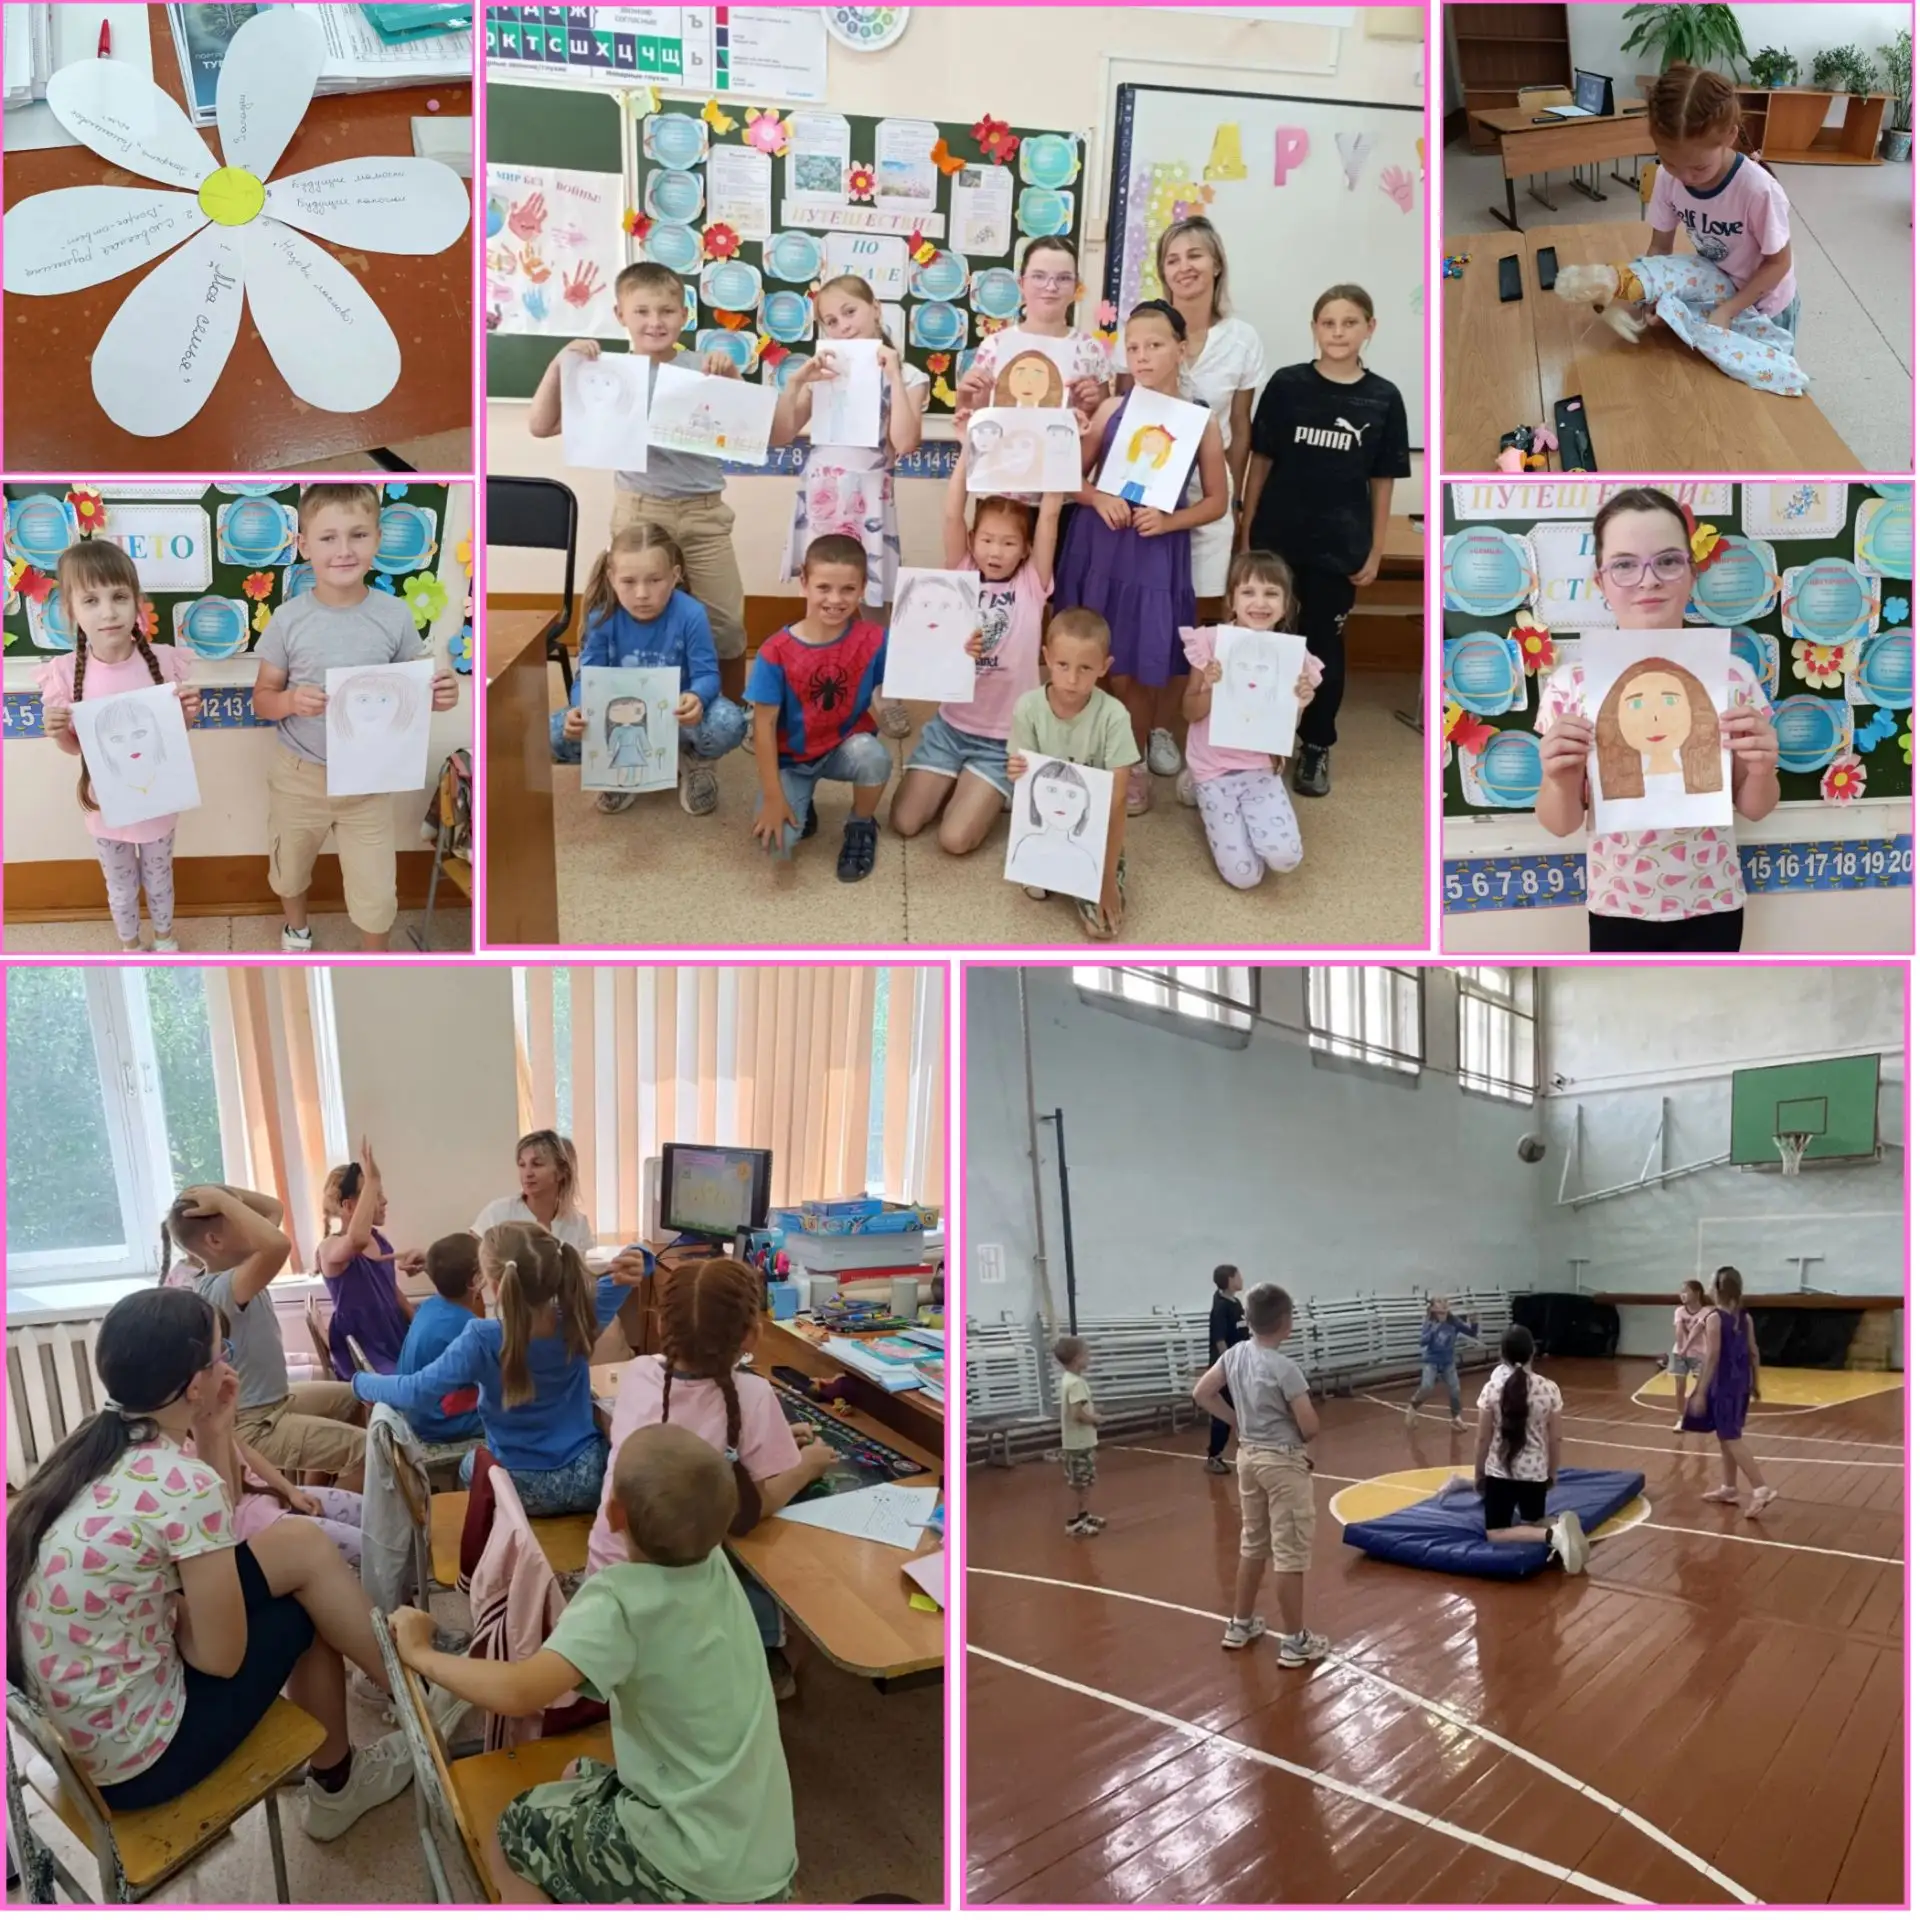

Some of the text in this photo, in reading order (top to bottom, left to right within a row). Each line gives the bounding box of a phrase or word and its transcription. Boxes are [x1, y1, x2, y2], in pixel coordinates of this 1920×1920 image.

[1701, 212, 1744, 237] Love
[851, 239, 880, 255] ПО
[1293, 425, 1353, 452] PUMA
[776, 448, 804, 466] 7 8
[906, 451, 922, 469] 13
[924, 452, 941, 469] 14
[943, 453, 960, 469] 15
[19, 705, 35, 727] 5
[200, 698, 220, 718] 12
[223, 698, 243, 717] 13
[1746, 850, 1913, 880] 15 16 17 18 19 20
[1445, 874, 1463, 899] 5
[1471, 872, 1490, 897] 6
[1495, 871, 1512, 896] 7
[1521, 869, 1540, 895] 8
[1547, 868, 1564, 893] 9
